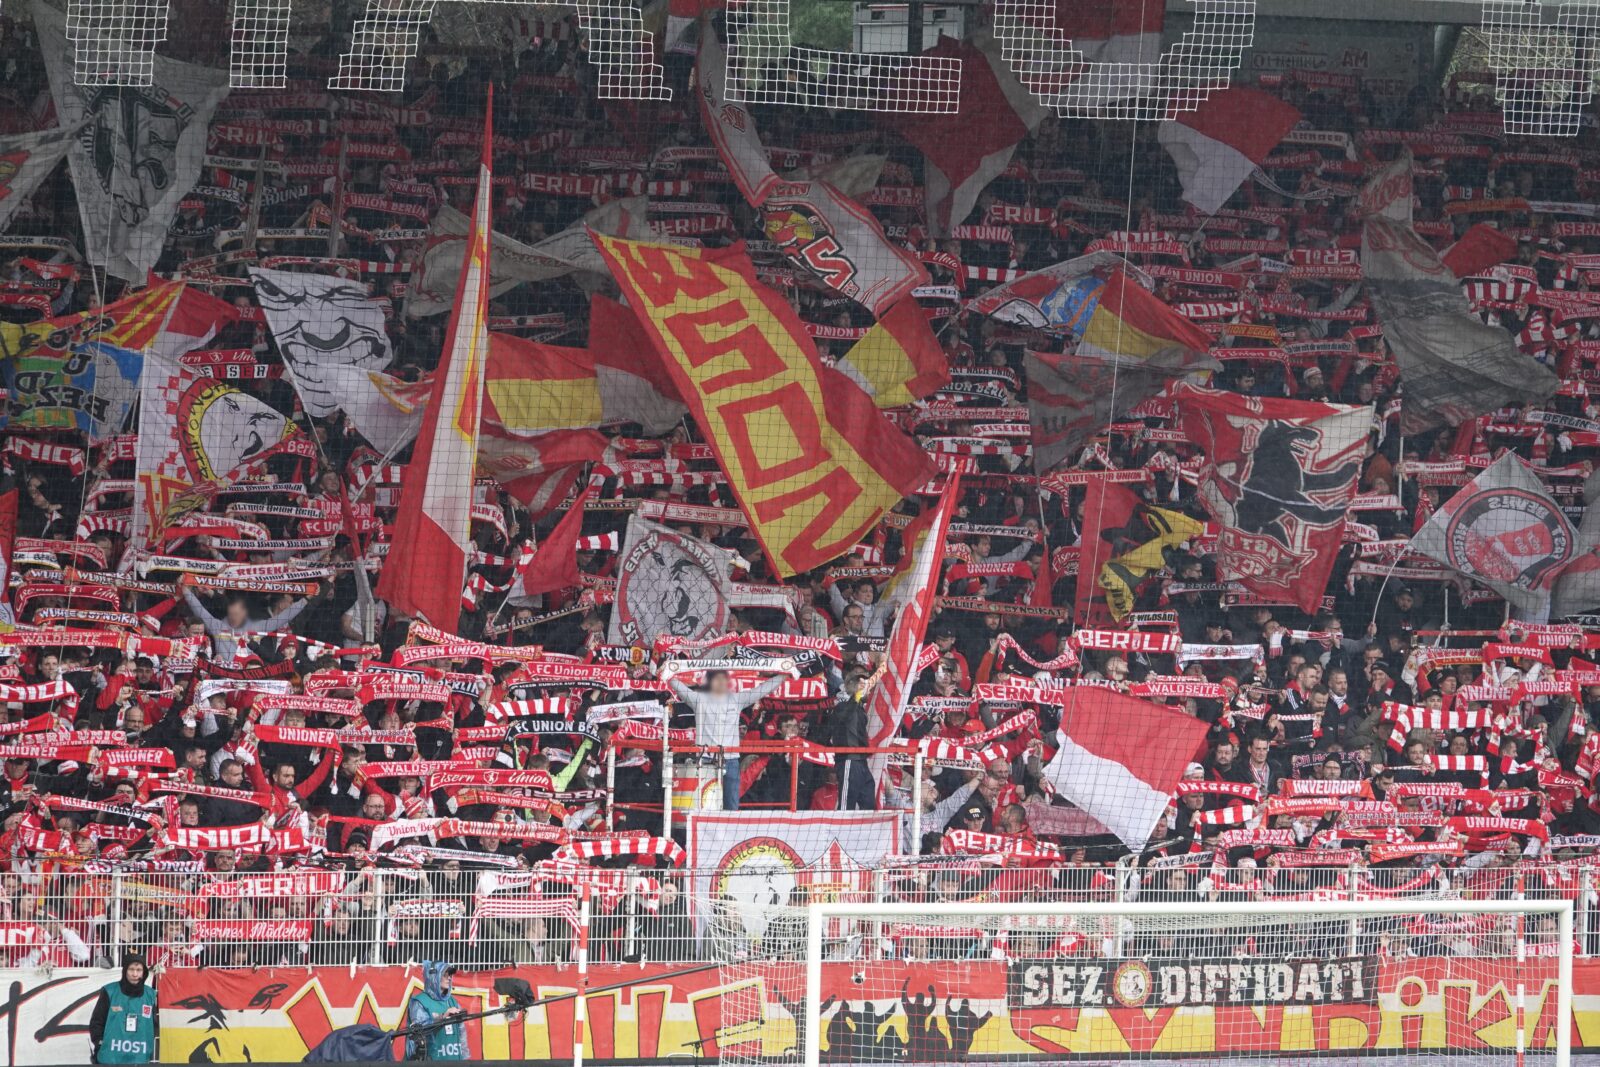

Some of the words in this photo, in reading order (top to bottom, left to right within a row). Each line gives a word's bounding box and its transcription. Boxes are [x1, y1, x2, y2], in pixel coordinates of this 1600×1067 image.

[1185, 270, 1223, 285] UNION
[814, 326, 854, 338] UNION
[200, 363, 284, 379] EISERN
[320, 501, 372, 517] UNON
[304, 520, 320, 533] FC
[966, 561, 1015, 574] UNIONER
[30, 569, 62, 582] WUHL
[194, 575, 237, 590] WUHLE
[750, 586, 772, 595] UNION
[21, 633, 102, 645] WALDSEITE
[748, 631, 791, 646] EISERN
[794, 635, 833, 650] UNION
[402, 647, 447, 661] EISERN
[449, 644, 487, 657] UNION
[1498, 644, 1544, 659] UNIONER
[553, 664, 589, 676] Union
[591, 667, 627, 679] Berlin
[380, 685, 392, 695] FC
[392, 685, 419, 696] UNION
[419, 685, 450, 697] BERLIN
[1145, 682, 1220, 695] WALDSEITE
[1523, 680, 1573, 693] UNIONER
[287, 699, 320, 712] UNION
[943, 700, 972, 708] Union
[515, 721, 530, 732] FC
[532, 720, 574, 732] UNION
[278, 727, 334, 745] UNIONER
[105, 749, 163, 766] UNIONER
[430, 771, 475, 790] Eisern
[507, 770, 549, 786] Union
[160, 780, 205, 796] EISERN
[210, 785, 254, 800] UNION
[1407, 784, 1467, 797] UNIONER
[484, 795, 497, 804] FC
[497, 797, 521, 807] UNION
[521, 800, 548, 810] BERLIN
[1465, 816, 1530, 832] UNIONER
[1160, 960, 1364, 1004] DIFFIDATI
[110, 1038, 147, 1054] HOST
